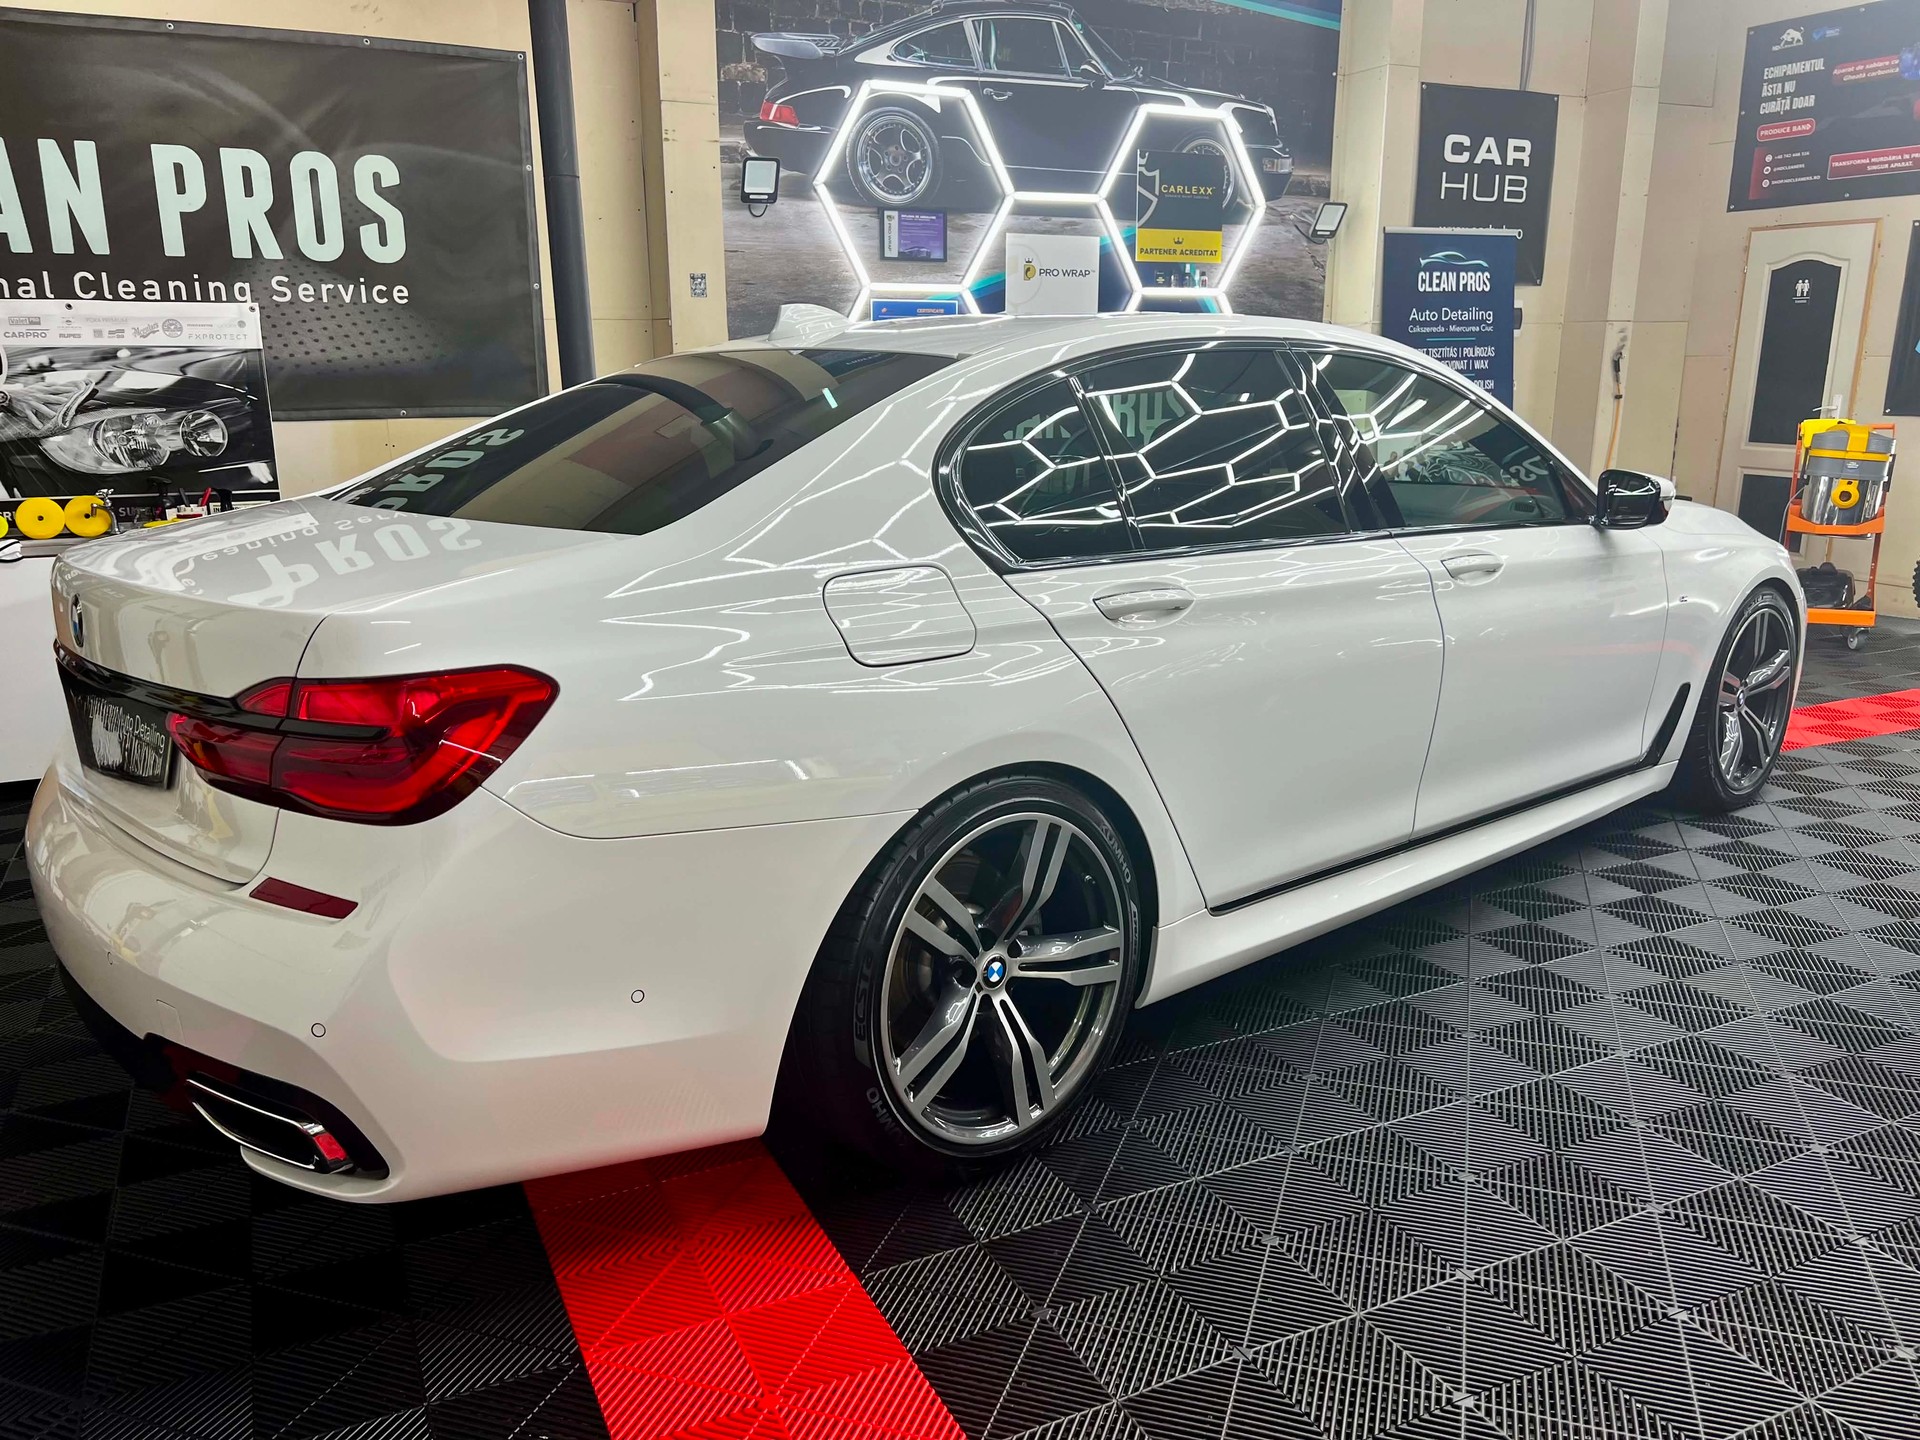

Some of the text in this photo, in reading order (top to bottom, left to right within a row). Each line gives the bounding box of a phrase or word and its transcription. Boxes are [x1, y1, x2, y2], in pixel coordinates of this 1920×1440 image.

[1763, 58, 1825, 80] ECHIPAMENTUL
[1761, 80, 1796, 97] ĂSTA NU
[1792, 95, 1816, 110] DOAR
[1760, 127, 1791, 137] PRODUCE
[1442, 134, 1532, 168] CAR
[1161, 184, 1213, 196] CARLEXX
[1440, 171, 1528, 204] HUB
[150, 143, 407, 264] PROS
[1140, 248, 1218, 257] PARTENER ACREDITAT
[1039, 268, 1091, 278] PRO WRAP
[73, 271, 251, 303] Cleaning
[271, 275, 409, 304] Service
[1417, 271, 1491, 292] CLEAN PROS
[1409, 307, 1494, 324] Auto Detailing
[4, 331, 48, 339] CARPRO
[1481, 324, 1494, 332] Ciuc
[1474, 360, 1489, 370] WAX
